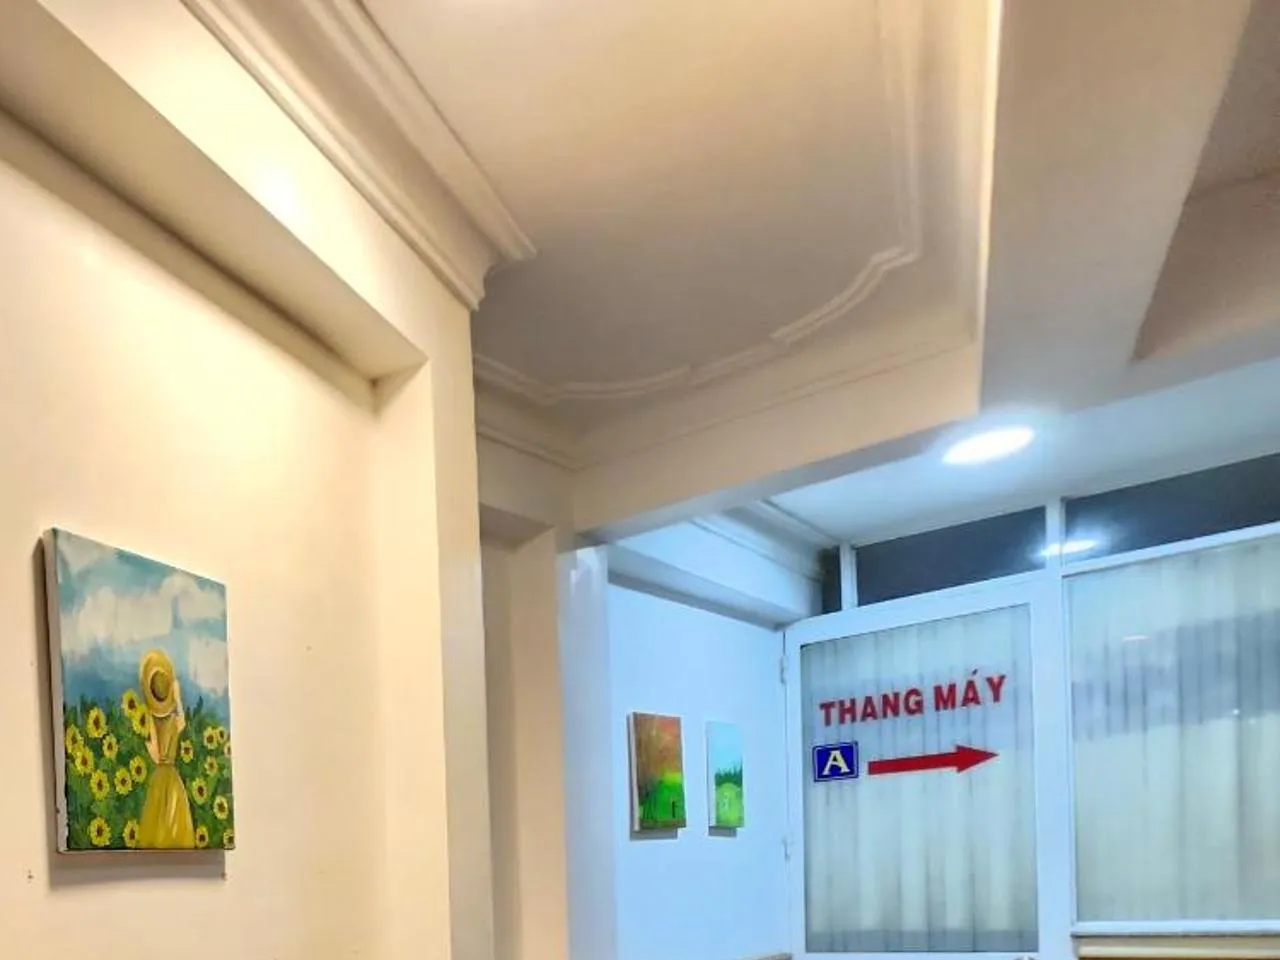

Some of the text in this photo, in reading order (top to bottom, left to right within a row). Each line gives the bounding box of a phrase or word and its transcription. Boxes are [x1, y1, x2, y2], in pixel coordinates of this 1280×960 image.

[819, 668, 1007, 727] THANG MÁY
[822, 750, 850, 776] A
